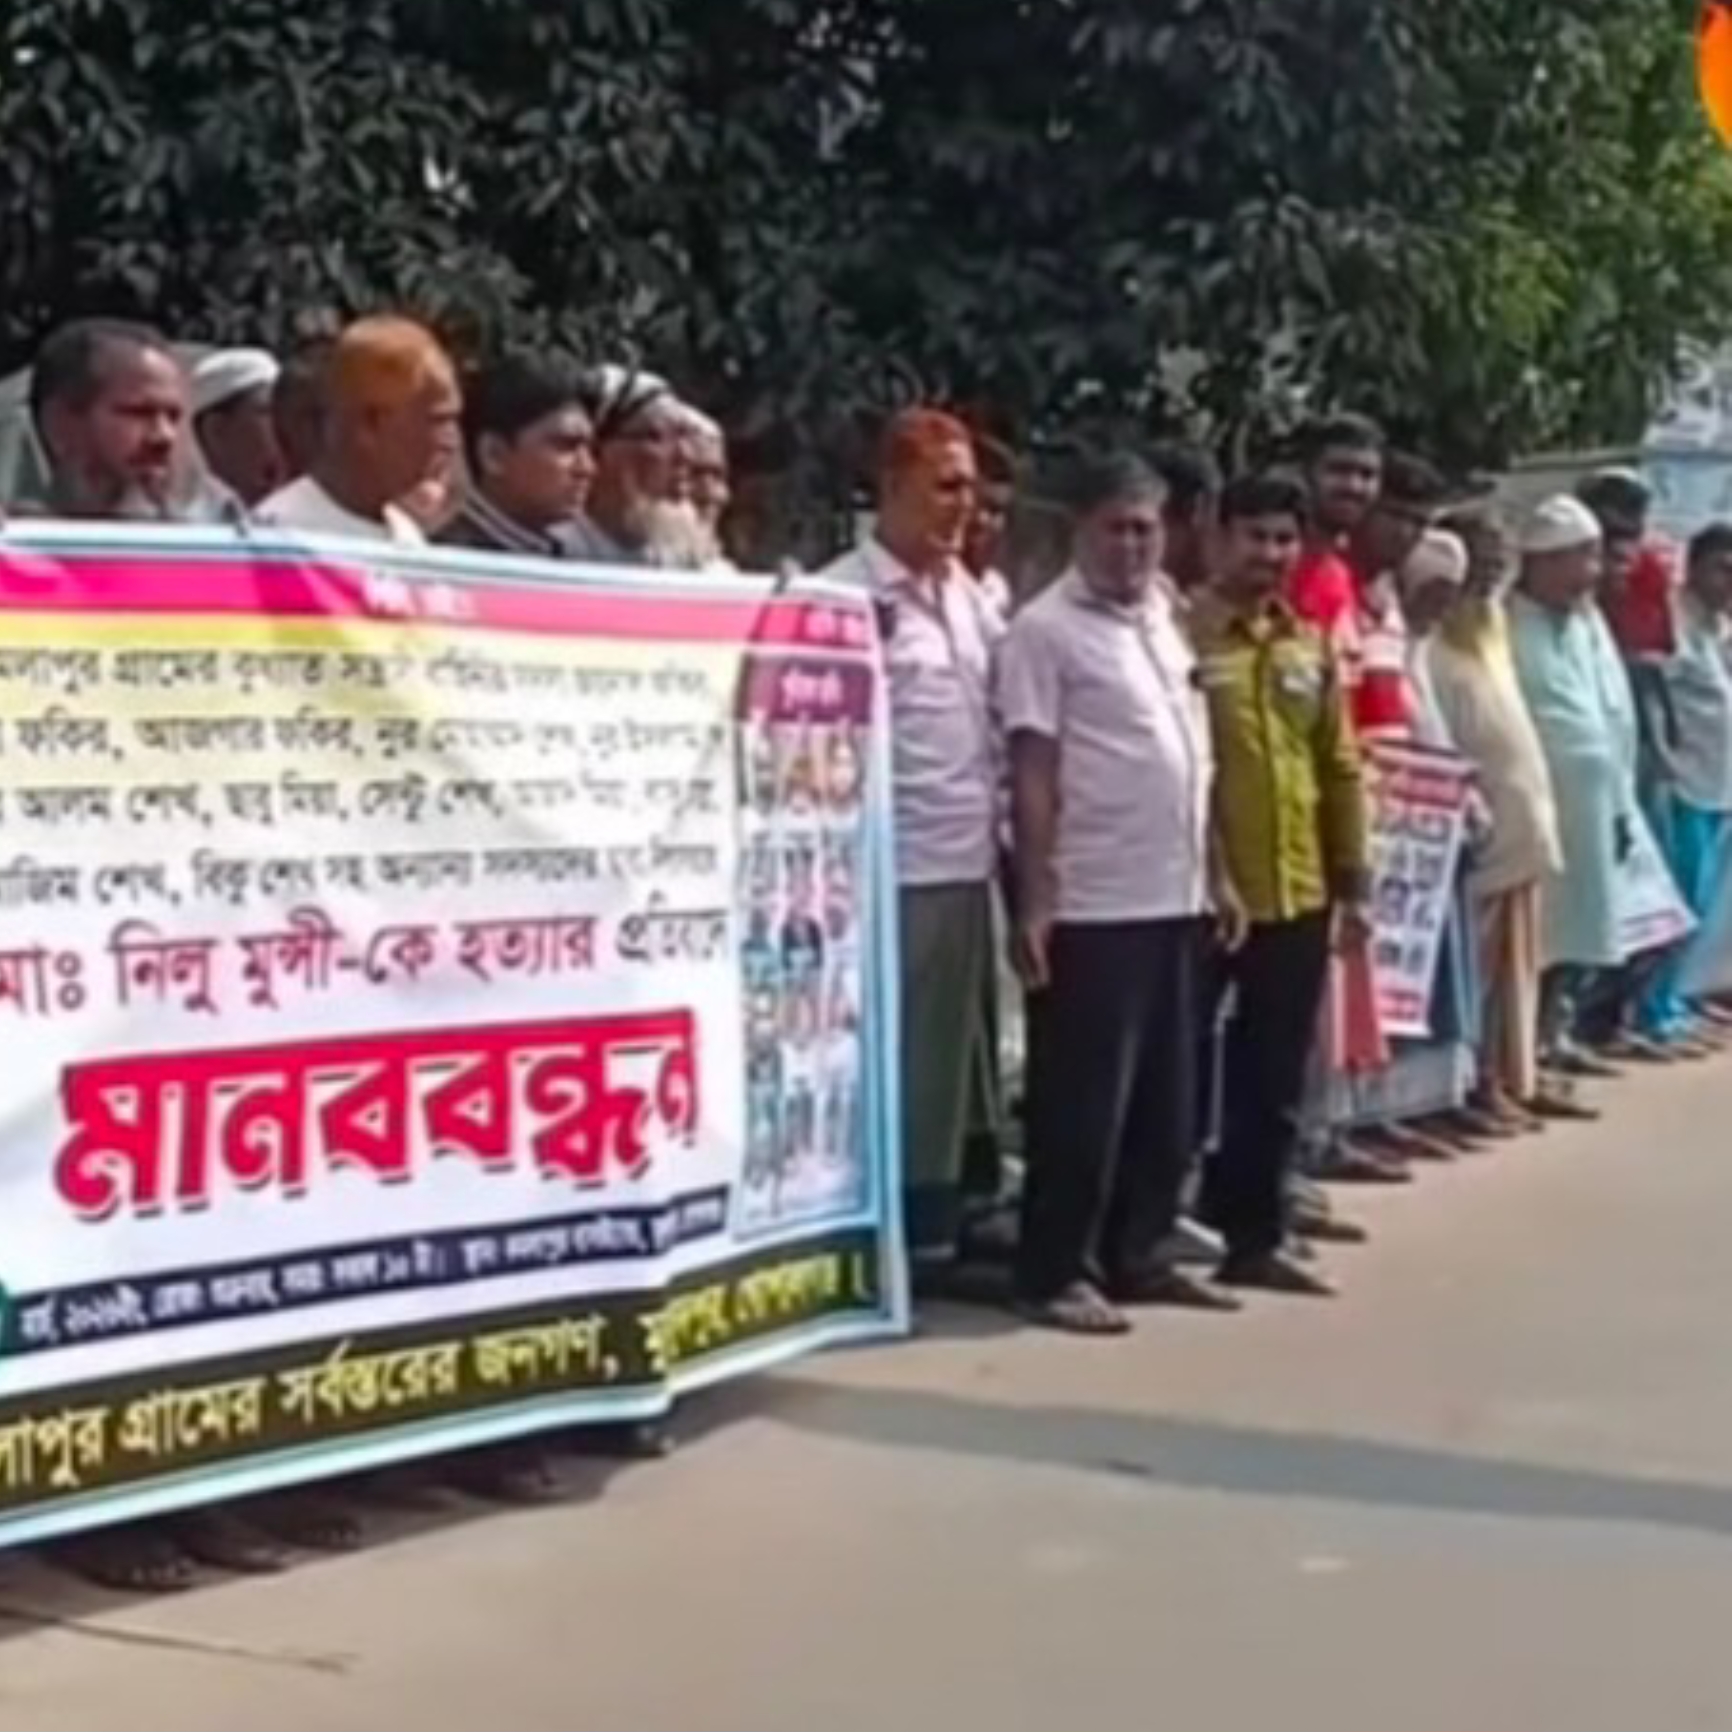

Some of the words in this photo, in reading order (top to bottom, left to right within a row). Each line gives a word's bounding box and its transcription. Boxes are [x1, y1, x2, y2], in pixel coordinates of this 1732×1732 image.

[112, 649, 219, 685] গ্রামের
[16, 786, 112, 823] আলম
[106, 917, 223, 1017] নিলু
[454, 915, 598, 984] হত্যার
[53, 1007, 700, 1226] মানববন্ধন
[118, 1376, 266, 1457] গ্রামের
[278, 1340, 463, 1423] সর্বস্তরের
